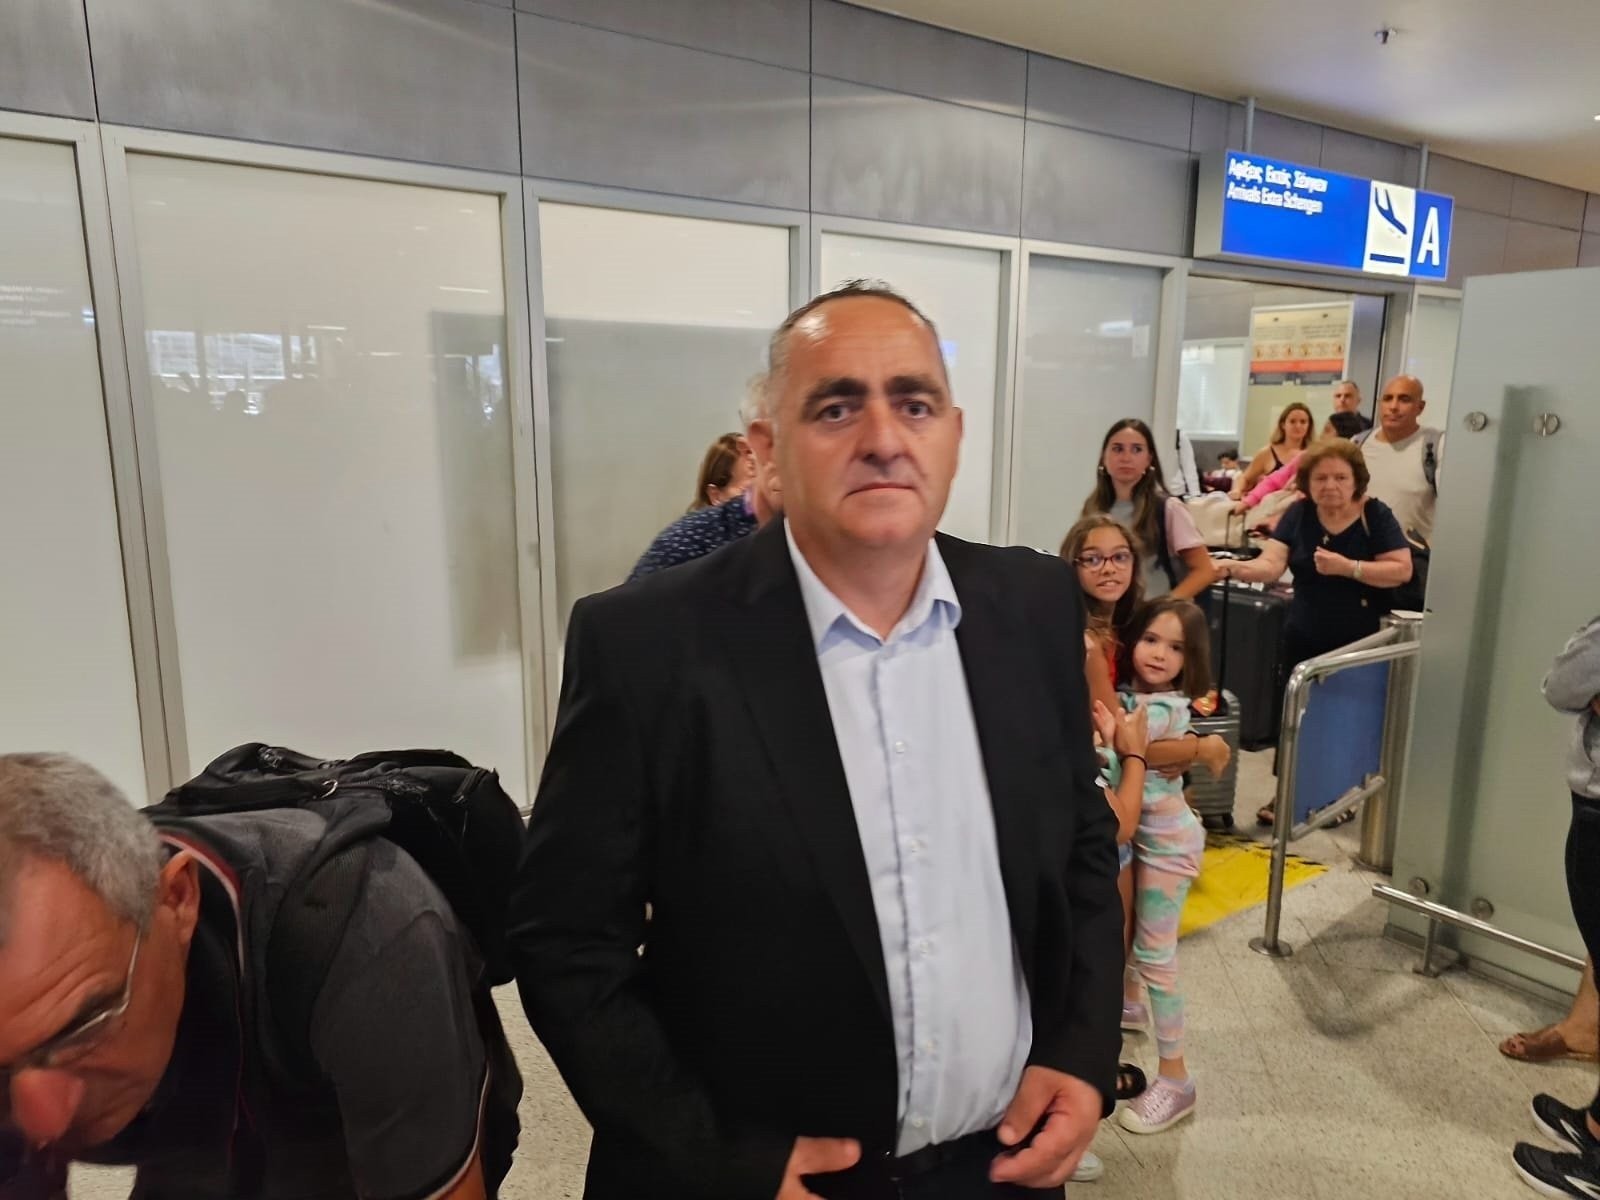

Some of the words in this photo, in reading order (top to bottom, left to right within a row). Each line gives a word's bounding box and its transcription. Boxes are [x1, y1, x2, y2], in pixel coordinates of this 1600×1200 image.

[1227, 182, 1261, 203] Arrivals
[1261, 187, 1283, 206] Extra
[1283, 191, 1323, 215] Schengen
[1417, 207, 1440, 266] A
